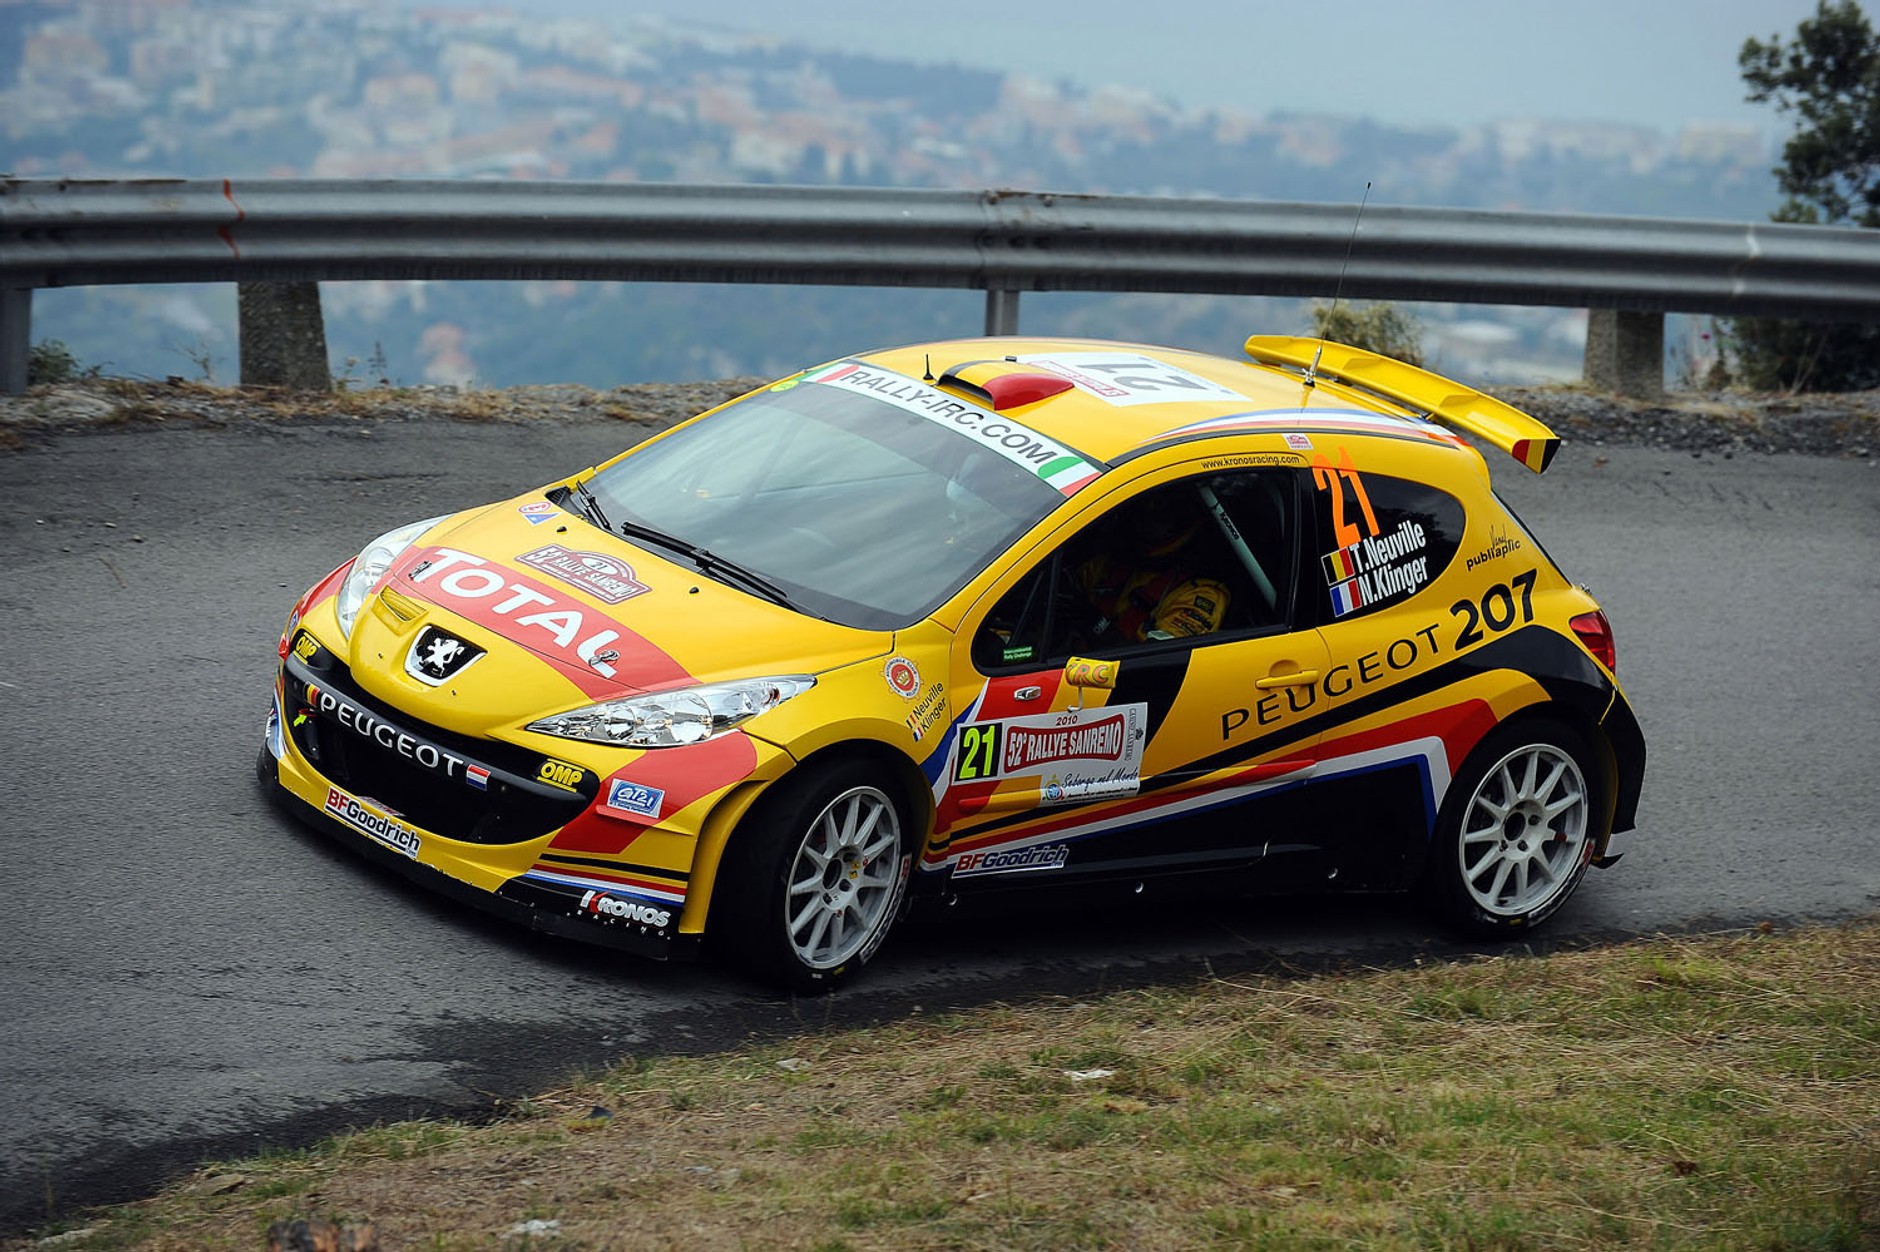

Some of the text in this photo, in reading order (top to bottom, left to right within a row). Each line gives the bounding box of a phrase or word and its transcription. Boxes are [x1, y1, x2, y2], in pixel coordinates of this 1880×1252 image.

[839, 370, 1058, 465] RALLY-IRC.COM
[1200, 454, 1300, 469] www.kronosracing.com
[1311, 445, 1381, 549] 21
[1349, 520, 1426, 575] T.Neuville
[1358, 556, 1428, 607] N.Klinger
[426, 547, 620, 681] TOTAL
[296, 635, 318, 659] OMP
[1222, 623, 1442, 741] PEUGEOT
[1450, 568, 1538, 652] 207
[912, 682, 944, 720] Neuville
[920, 697, 946, 733] Klinger
[1055, 715, 1078, 726] 2010
[320, 692, 464, 779] PEUGEOT
[958, 724, 996, 780] 21
[1027, 731, 1068, 763] RALLYE
[1068, 720, 1122, 756] SANREMO
[540, 762, 583, 786] OMP
[326, 787, 421, 851] BFGoodrich
[955, 844, 1070, 871] BFGoodrich
[580, 888, 671, 928] KRONOS
